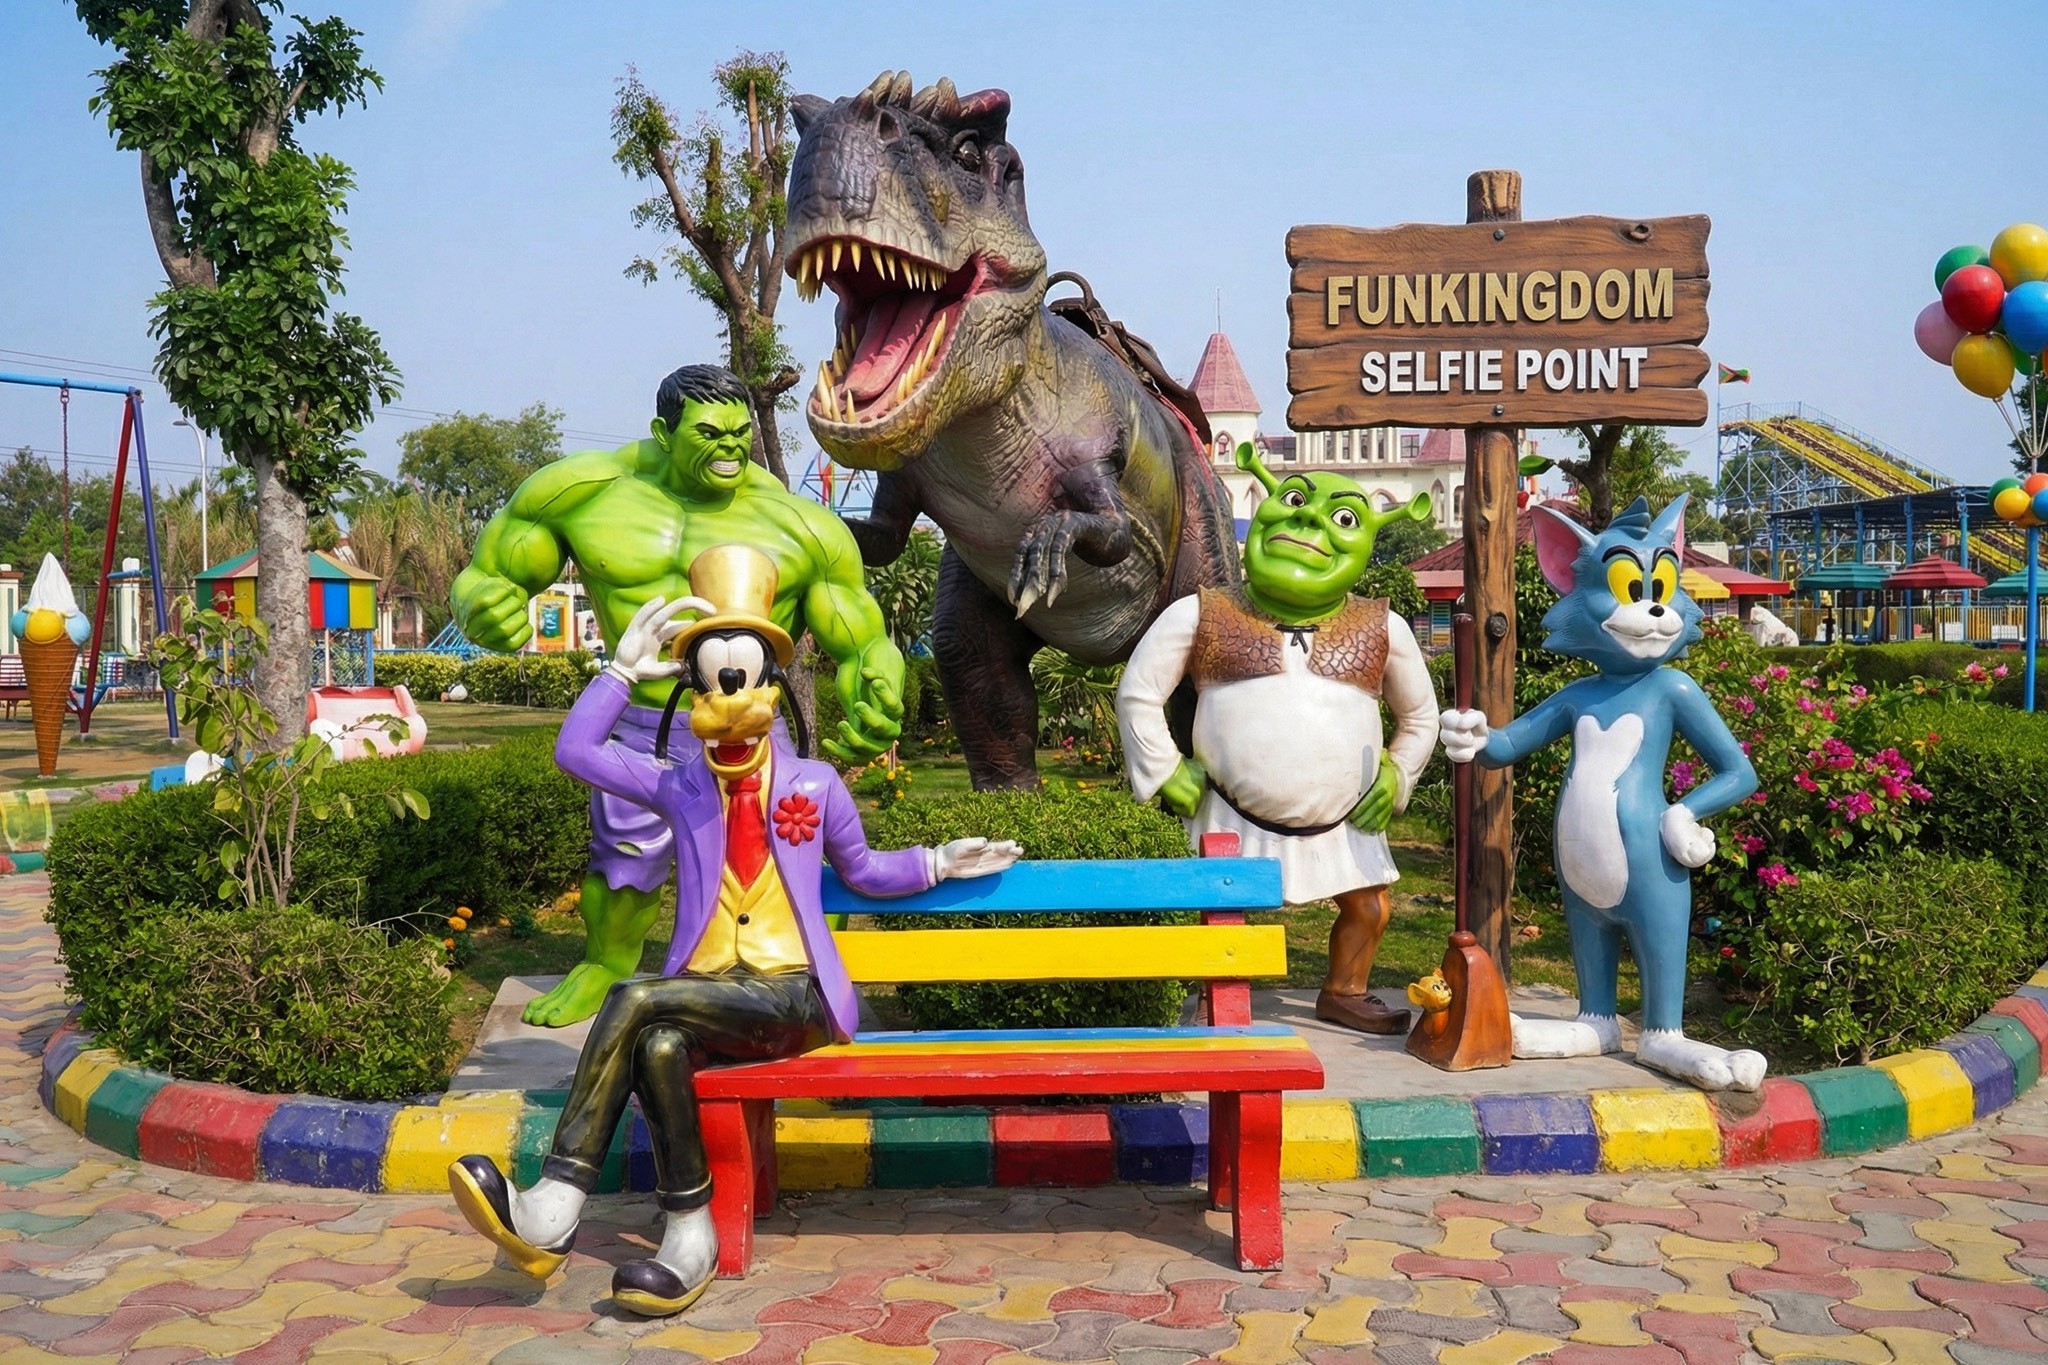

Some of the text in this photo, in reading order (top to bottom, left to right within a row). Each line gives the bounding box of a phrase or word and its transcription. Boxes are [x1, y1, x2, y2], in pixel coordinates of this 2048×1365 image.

[1326, 268, 1674, 326] FUNKINGDOM
[1361, 347, 1648, 393] SELFIE POINT
